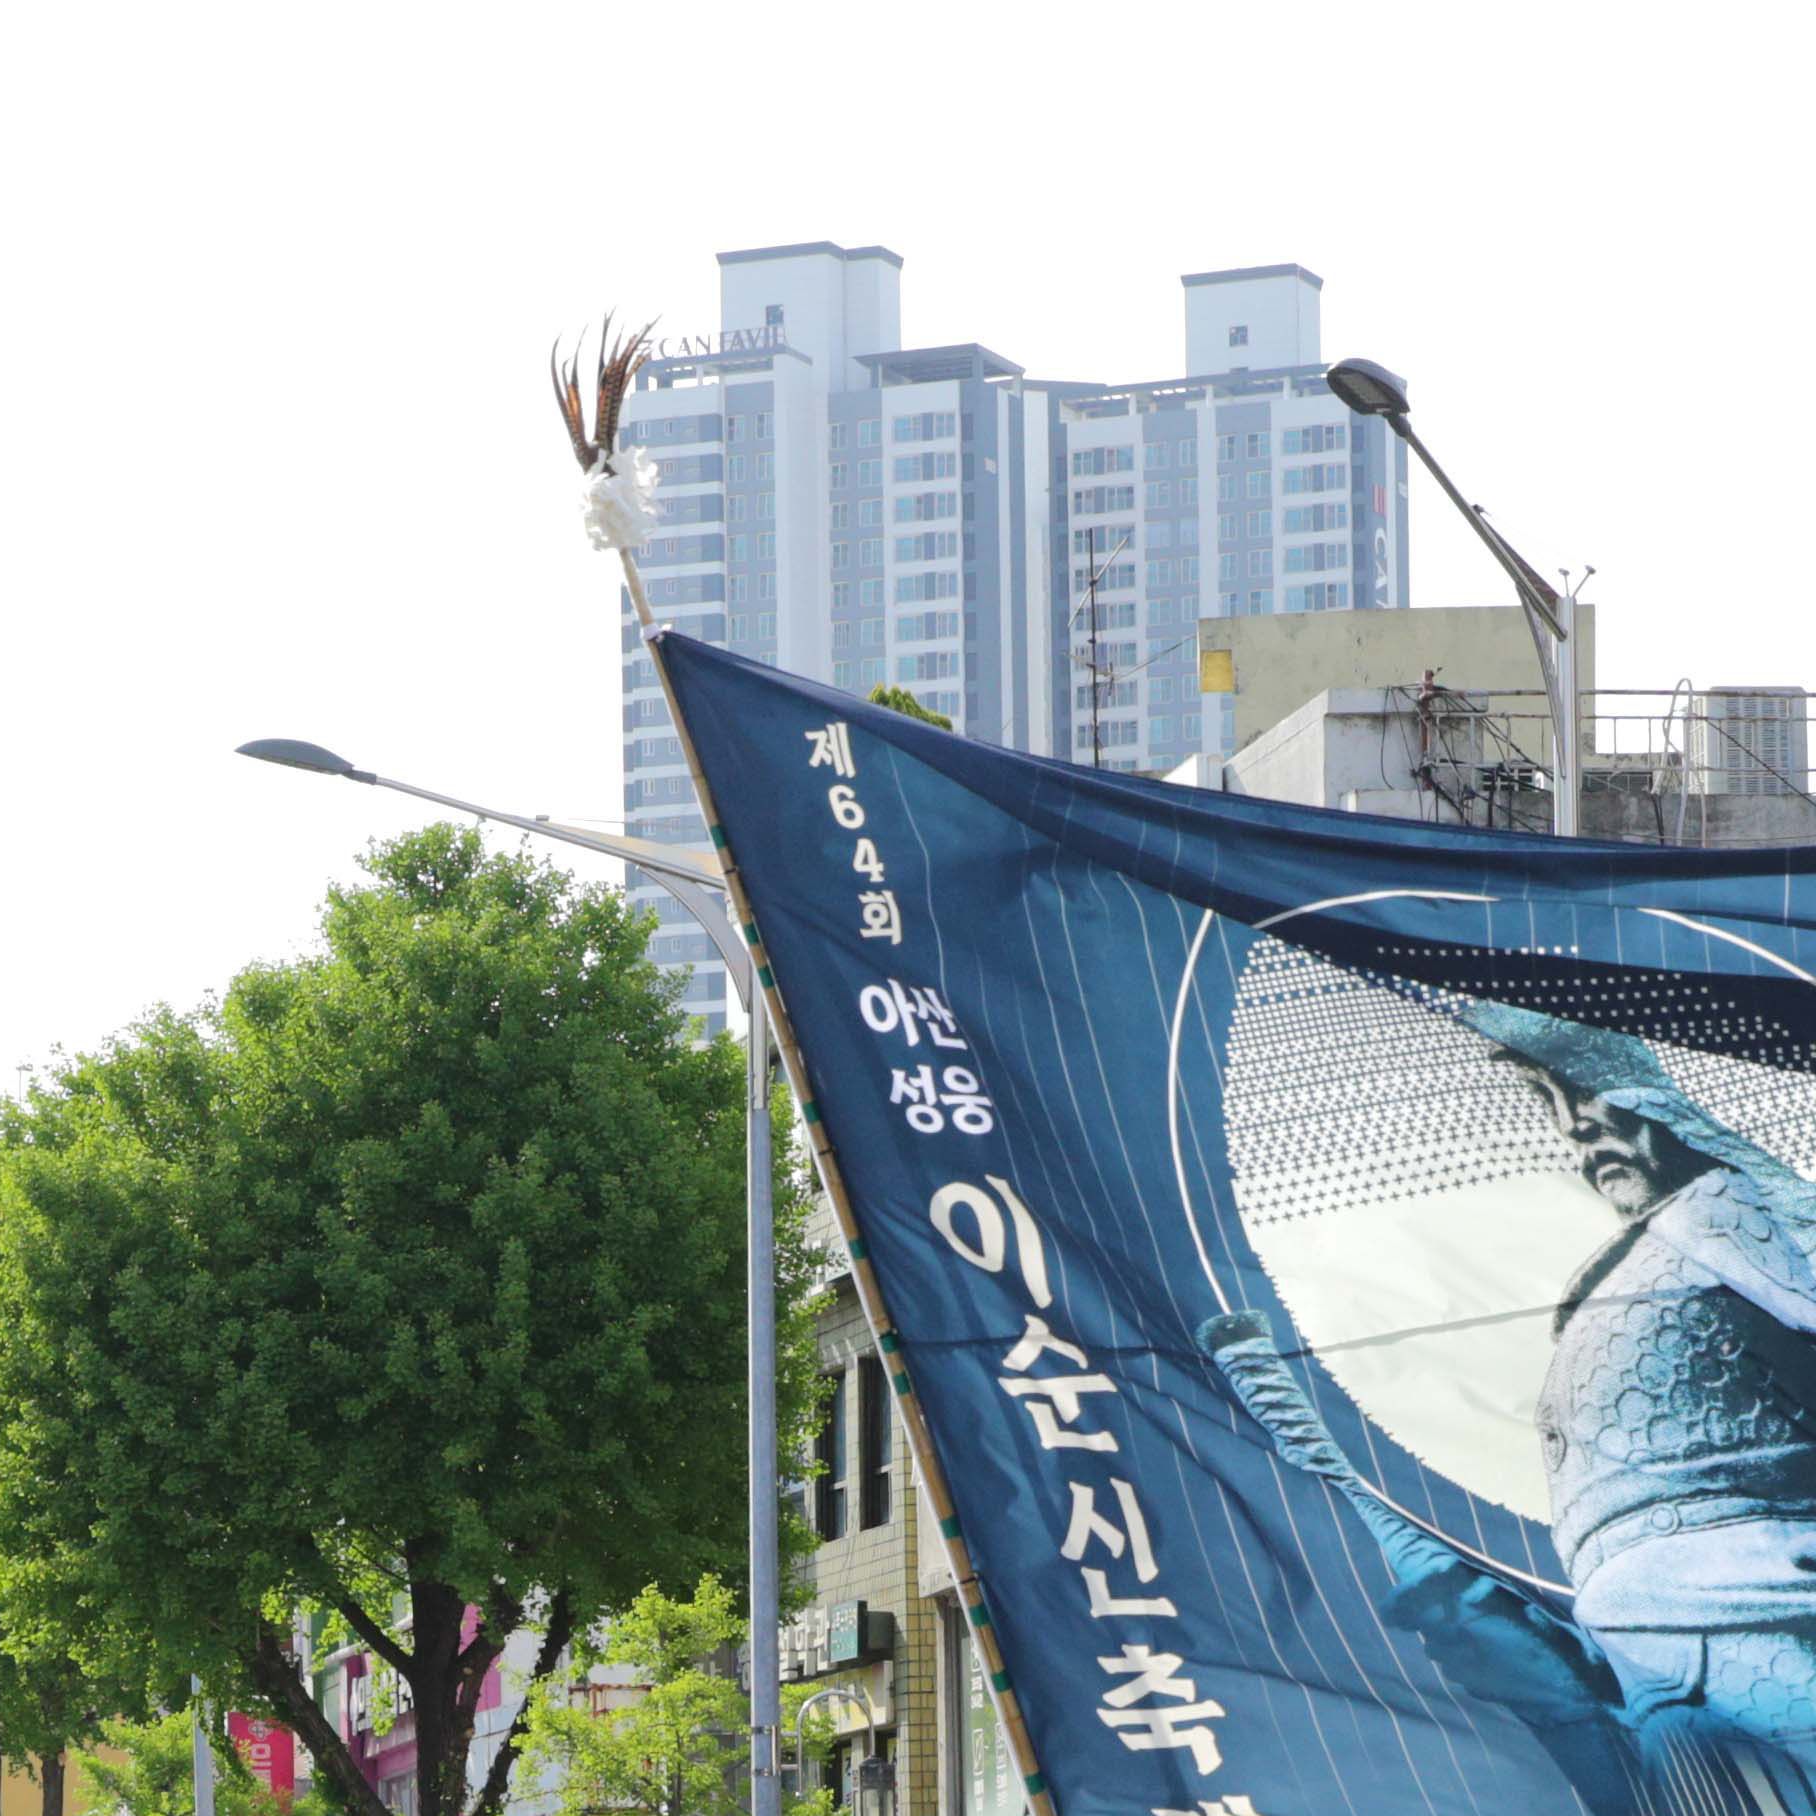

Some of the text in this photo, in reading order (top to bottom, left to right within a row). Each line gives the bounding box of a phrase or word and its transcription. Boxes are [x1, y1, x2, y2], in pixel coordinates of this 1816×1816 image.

[805, 721, 903, 946] 제64회
[858, 977, 968, 1051] 아산
[888, 1067, 996, 1137] 성웅
